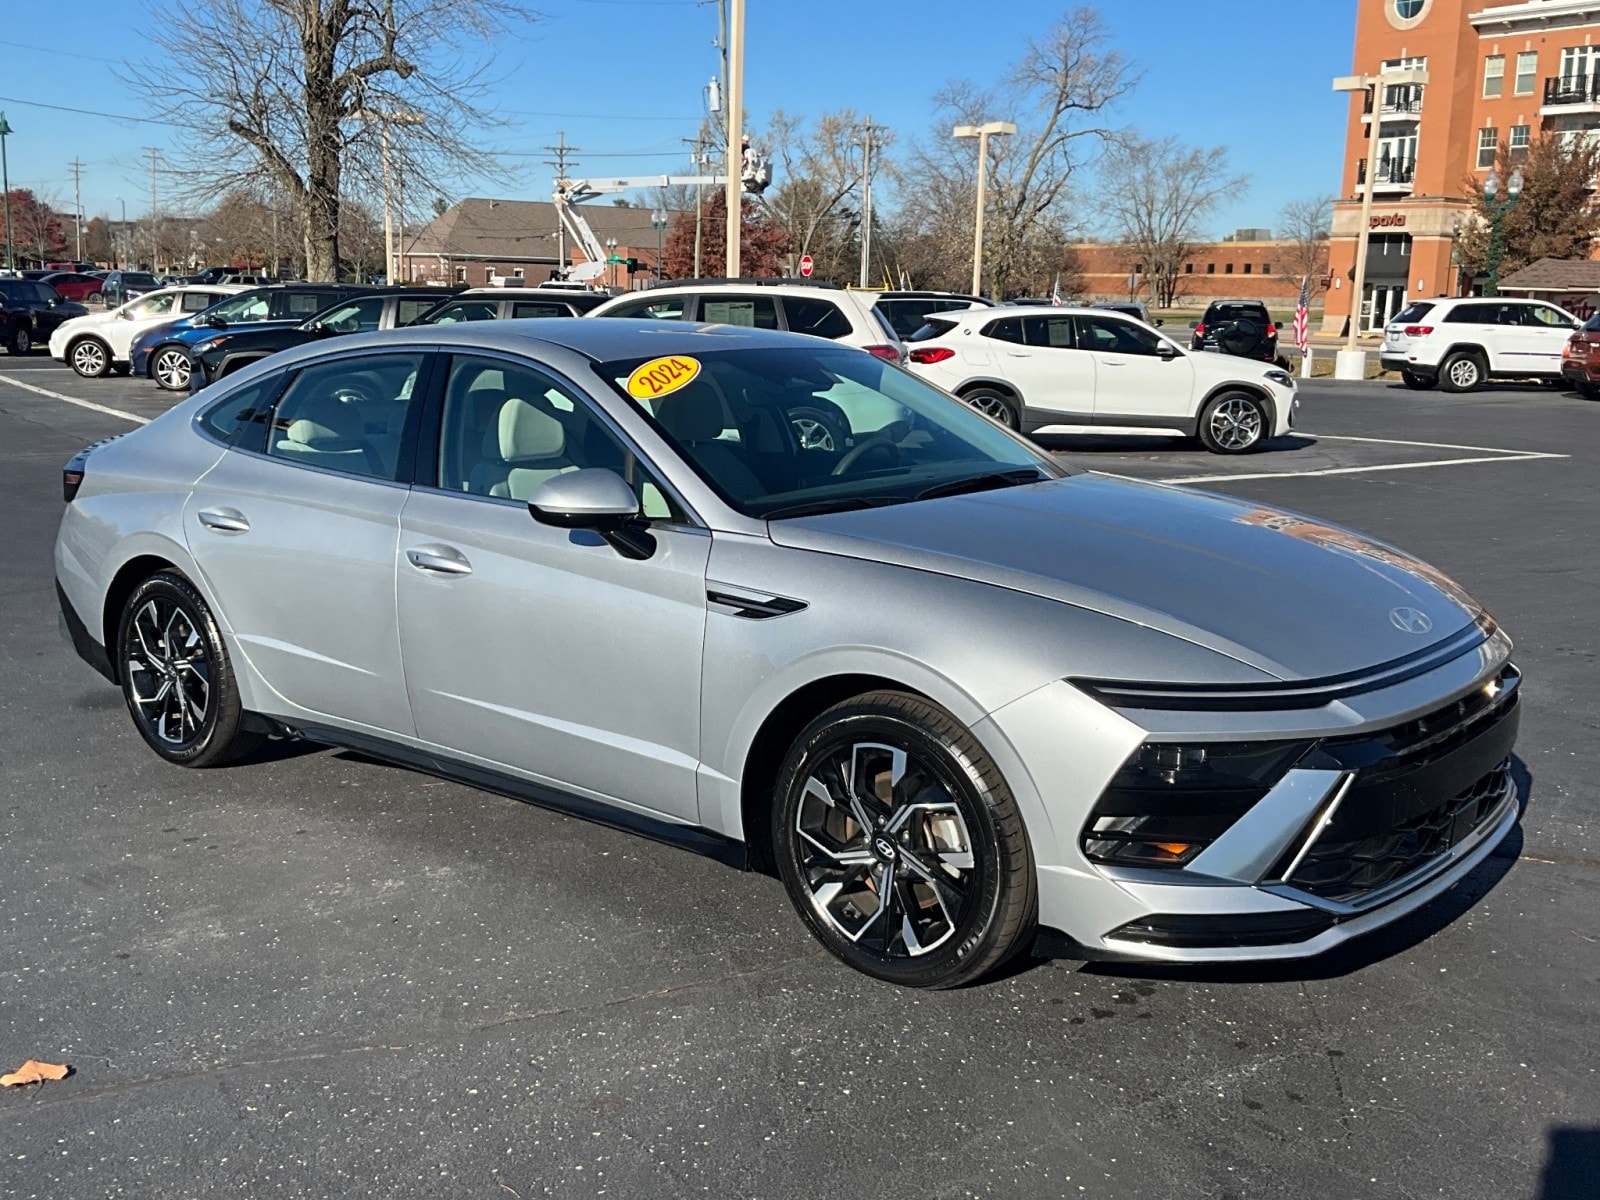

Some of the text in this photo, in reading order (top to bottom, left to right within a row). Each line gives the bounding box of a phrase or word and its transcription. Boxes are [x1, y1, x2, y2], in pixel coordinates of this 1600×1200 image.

[1369, 213, 1406, 229] pavia
[801, 261, 813, 270] STOP
[639, 359, 692, 393] 2024
